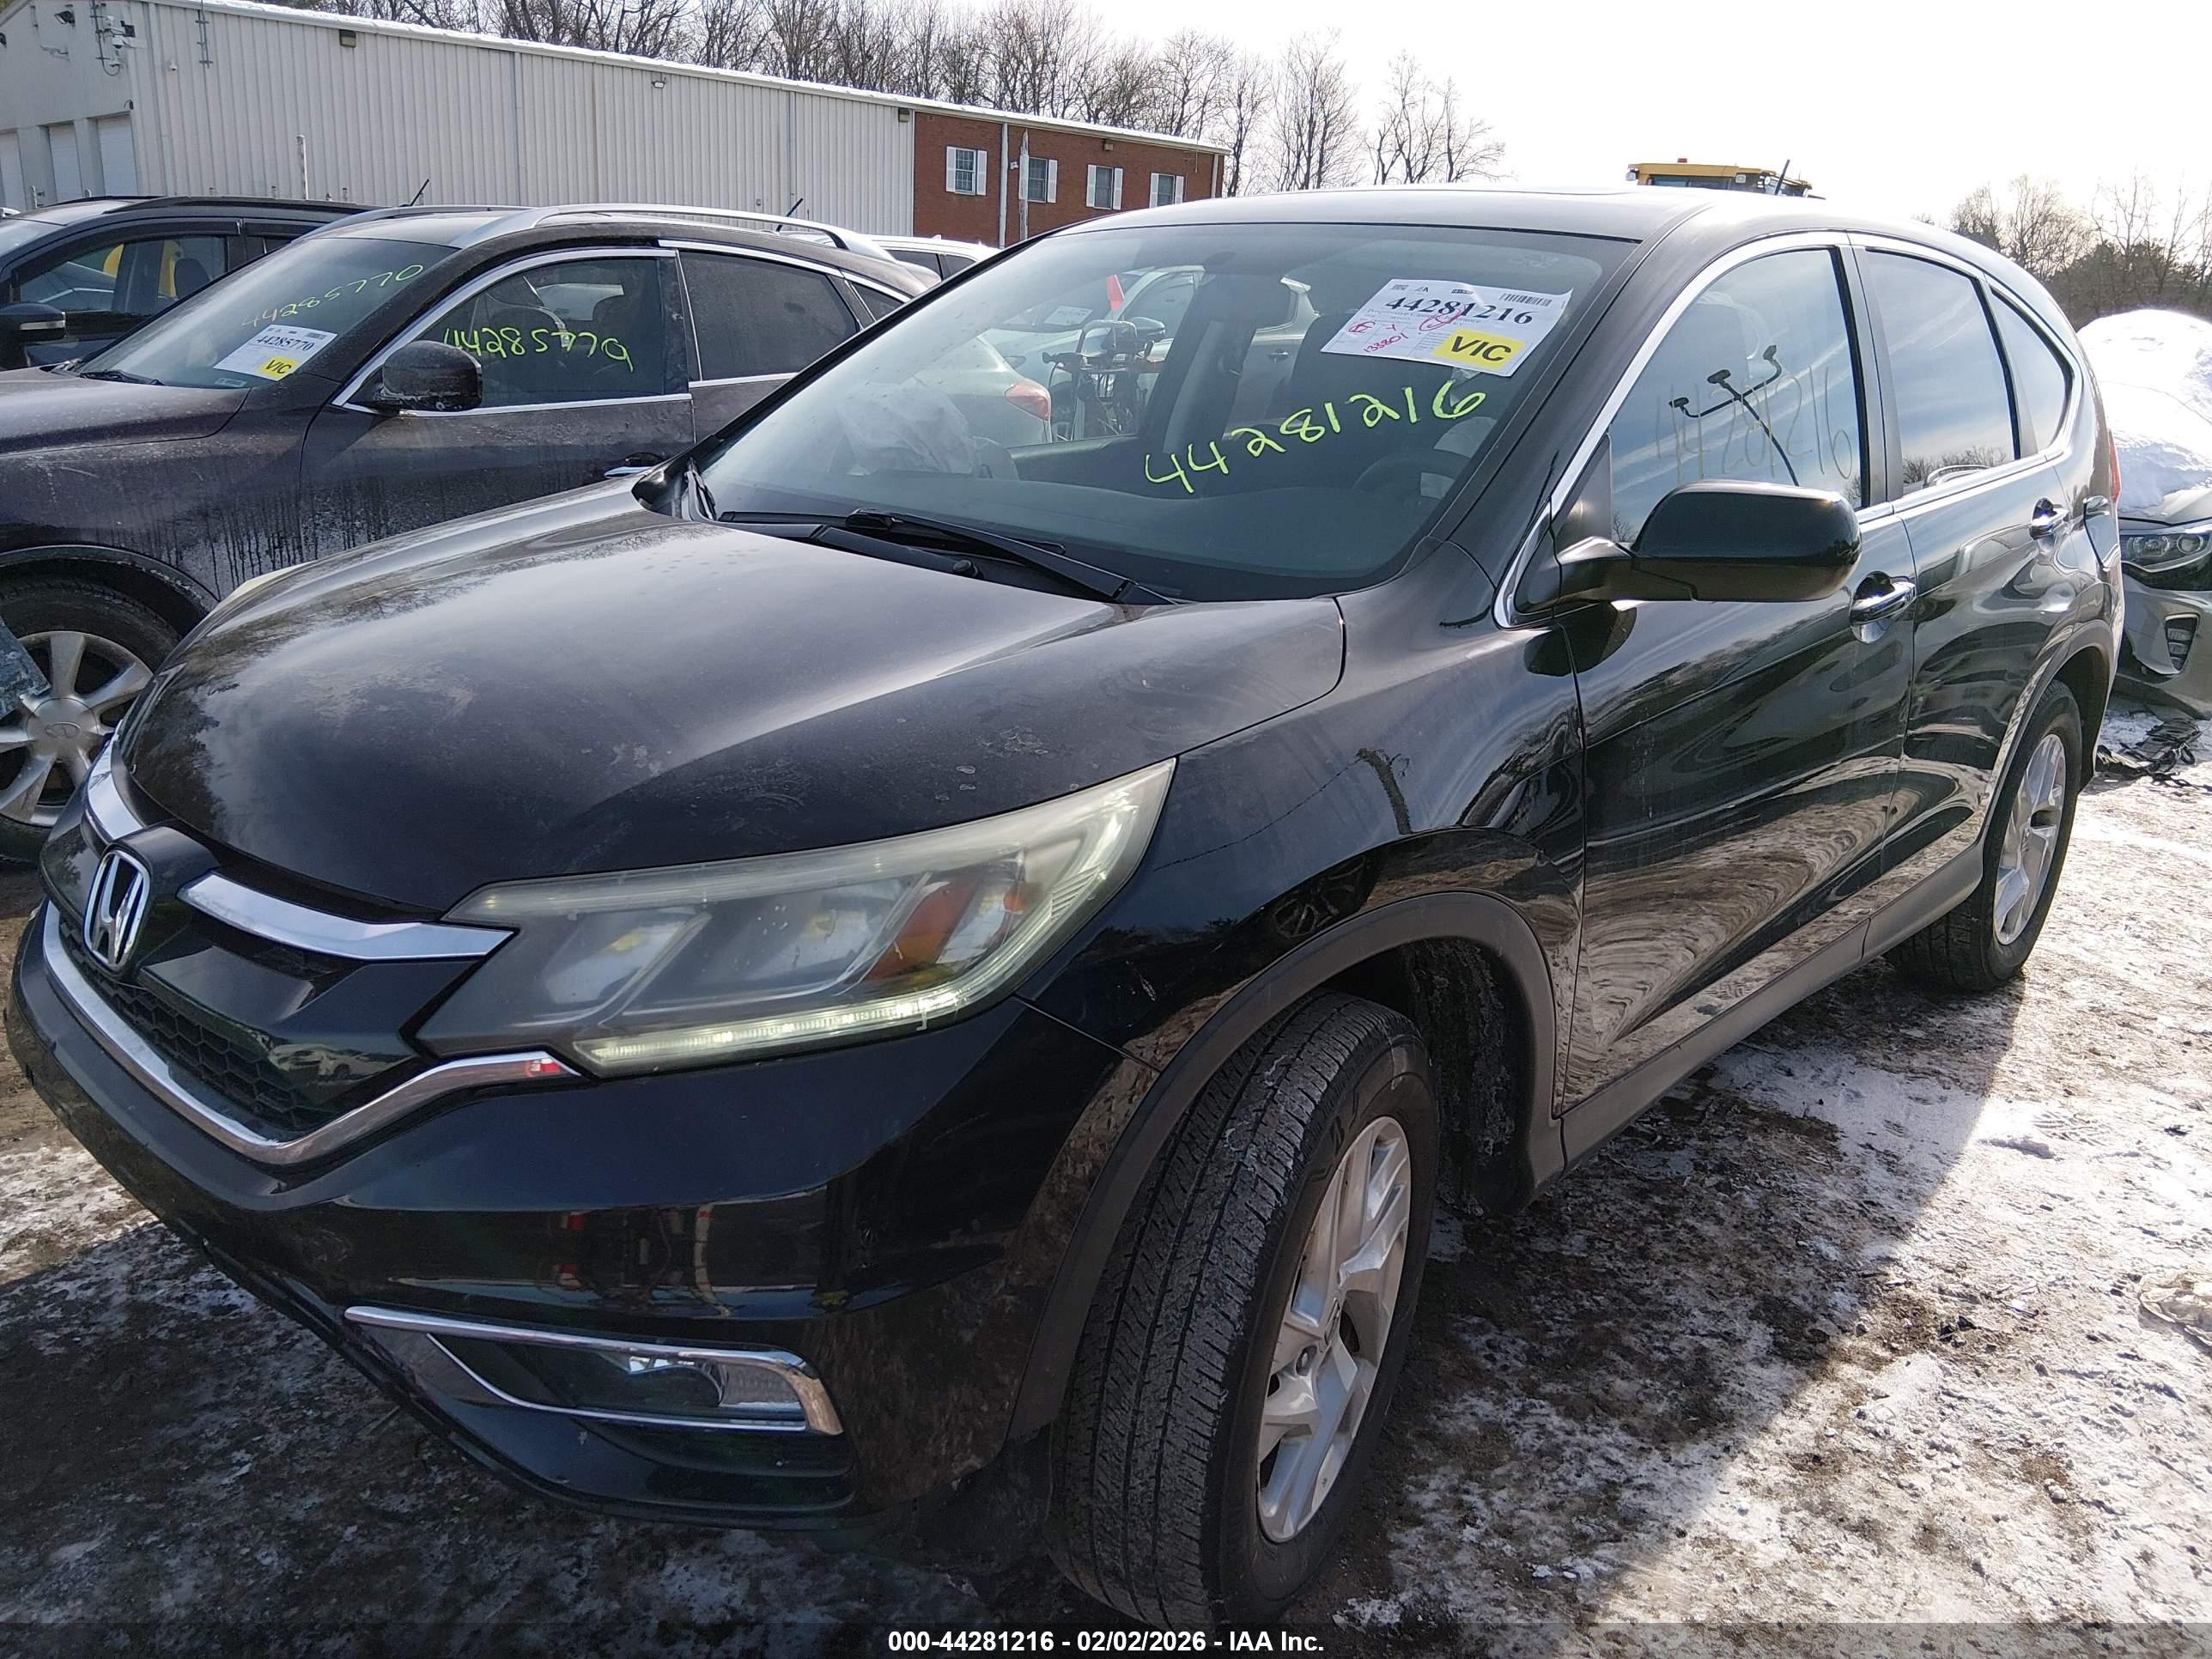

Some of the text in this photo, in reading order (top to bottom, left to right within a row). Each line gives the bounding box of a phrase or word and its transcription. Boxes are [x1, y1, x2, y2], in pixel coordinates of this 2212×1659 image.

[241, 264, 424, 327] 44285770
[1385, 296, 1536, 325] 44281216
[256, 334, 316, 351] 44285770
[1450, 336, 1511, 362] VIC
[264, 359, 293, 374] VIC
[1145, 380, 1486, 494] 44281216
